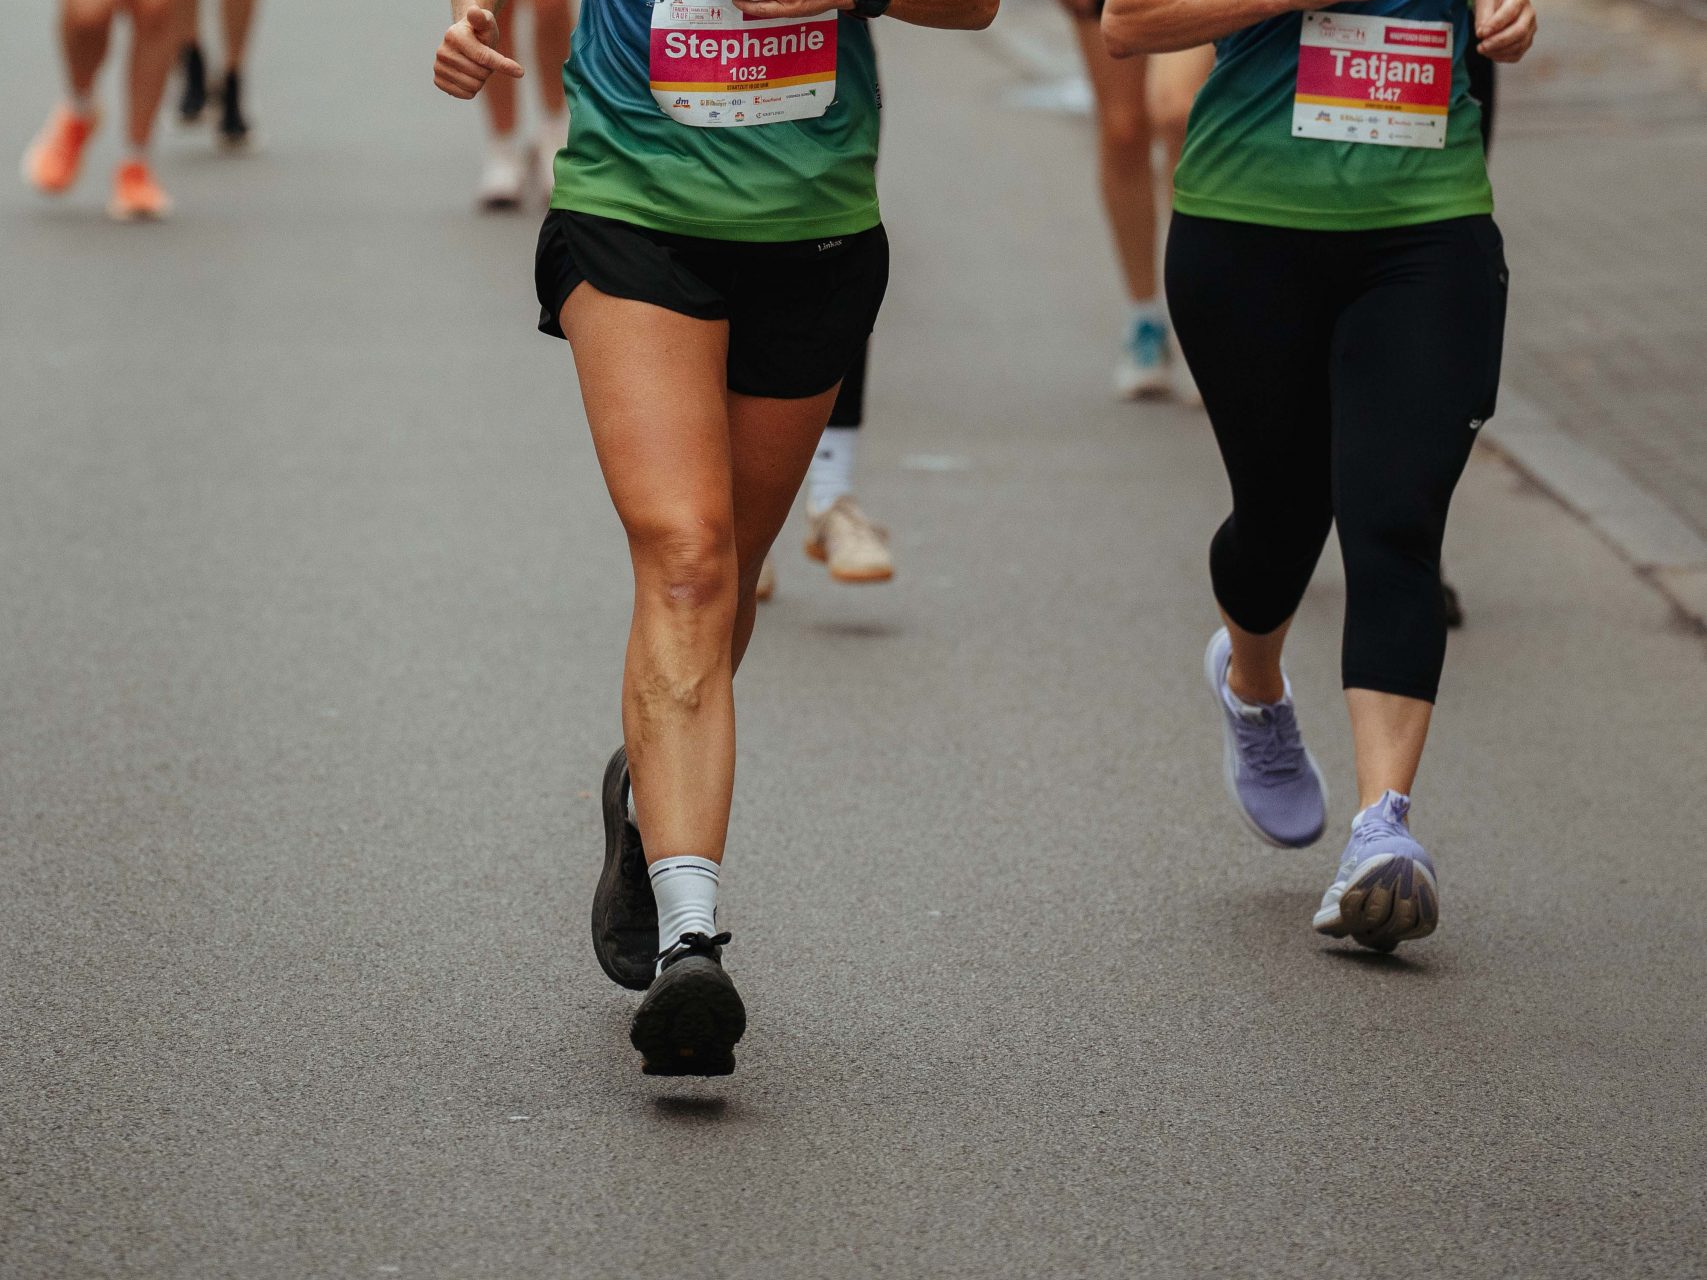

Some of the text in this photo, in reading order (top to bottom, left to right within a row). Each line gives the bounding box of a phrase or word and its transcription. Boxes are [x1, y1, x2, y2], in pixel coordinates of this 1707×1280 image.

[665, 26, 825, 65] Stephanie
[729, 65, 767, 81] 1032
[1330, 50, 1434, 87] Tatjana
[675, 97, 689, 105] dm
[1368, 86, 1401, 102] 1447
